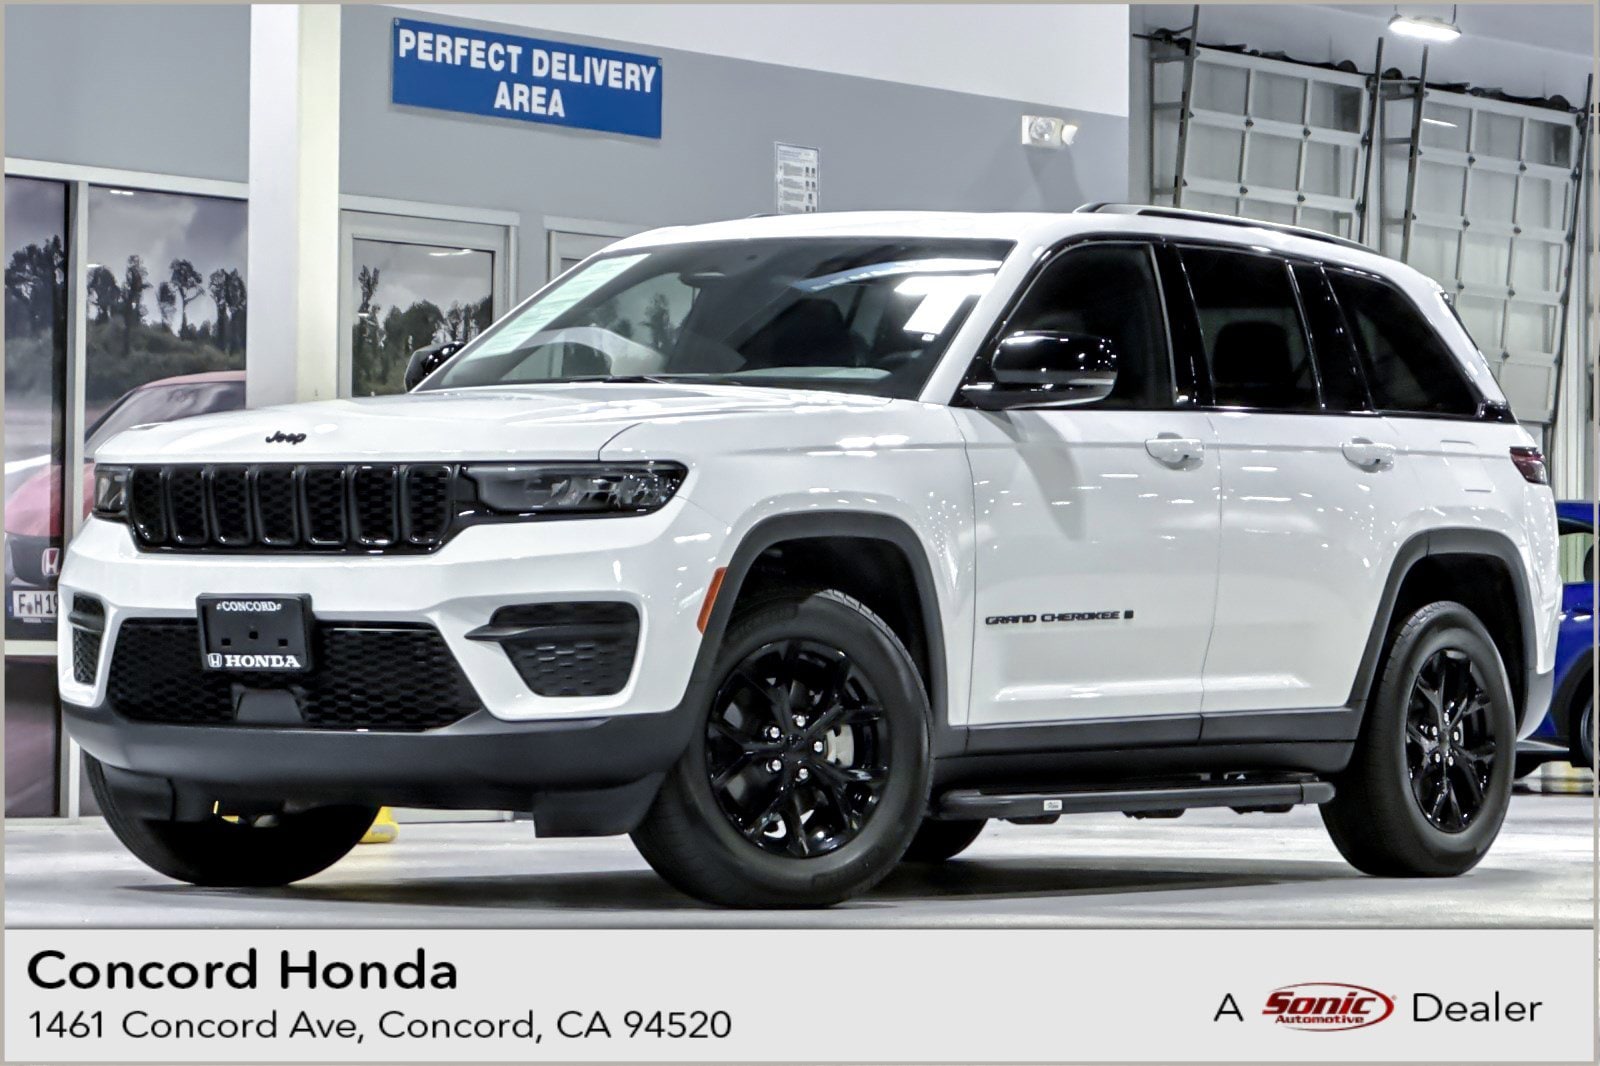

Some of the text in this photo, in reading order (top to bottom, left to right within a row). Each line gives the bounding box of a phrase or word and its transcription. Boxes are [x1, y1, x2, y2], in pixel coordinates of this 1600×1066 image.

[399, 28, 656, 93] PERFECT DELIVERY
[494, 81, 566, 118] AREA
[265, 430, 307, 445] Jeep
[221, 601, 277, 612] CONCORD
[985, 611, 1120, 625] GRAND CHEROKEE
[225, 654, 301, 668] HONDA
